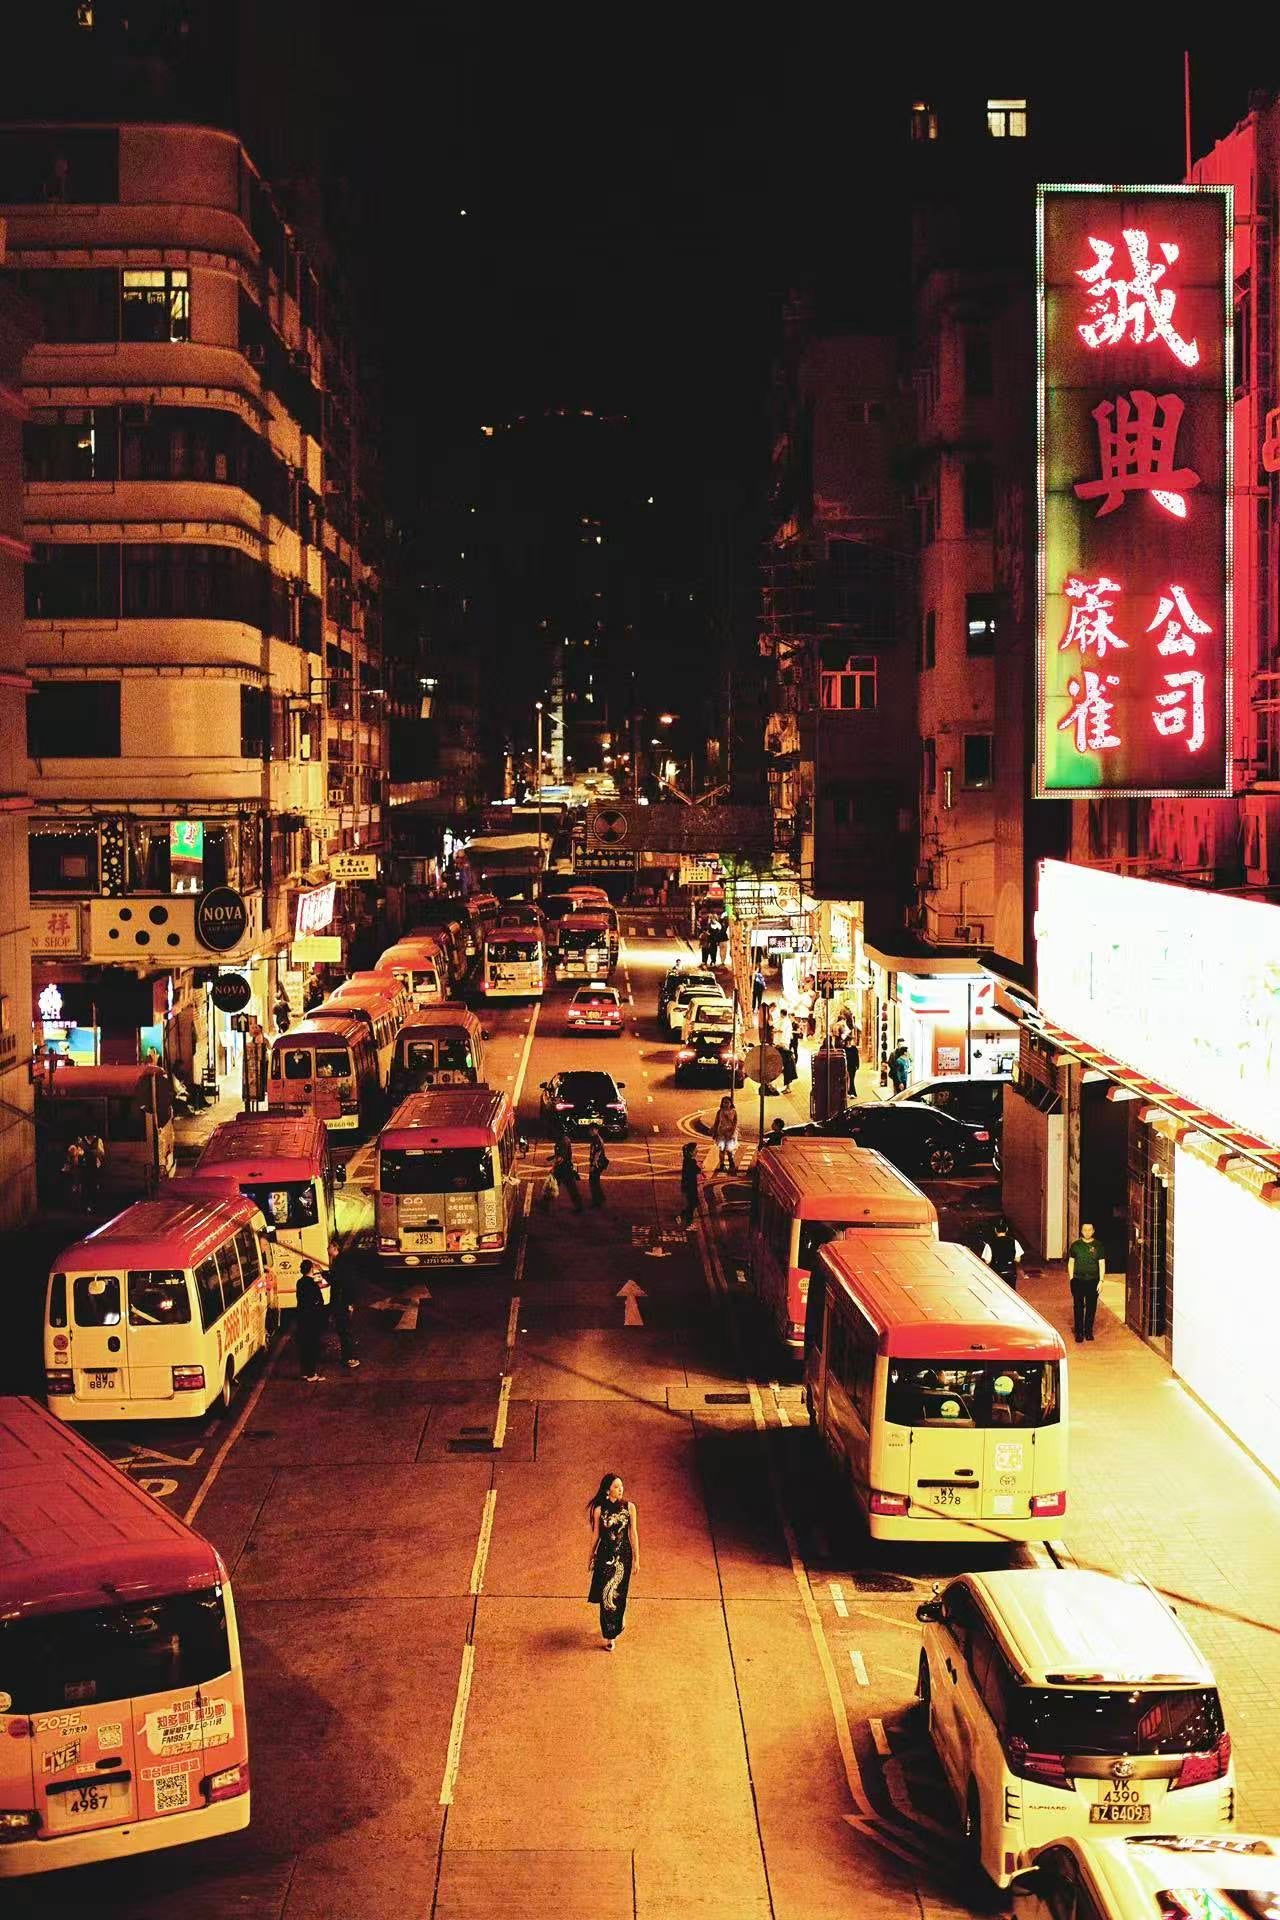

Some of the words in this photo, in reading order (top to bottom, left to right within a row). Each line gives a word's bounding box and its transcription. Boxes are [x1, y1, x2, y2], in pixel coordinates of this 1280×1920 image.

[1075, 228, 1201, 518] 誠興
[1145, 583, 1213, 753] 公司
[204, 906, 242, 921] NOVA
[47, 912, 71, 936] 祥
[44, 937, 71, 947] SHOP
[215, 985, 246, 995] NOVA
[940, 1488, 954, 1497] WX
[933, 1496, 961, 1505] 3278
[161, 1732, 191, 1745] FM99.7
[1112, 1780, 1130, 1791] VK
[79, 1786, 98, 1801] VC
[1103, 1791, 1140, 1803] 4390
[70, 1796, 108, 1813] 4987
